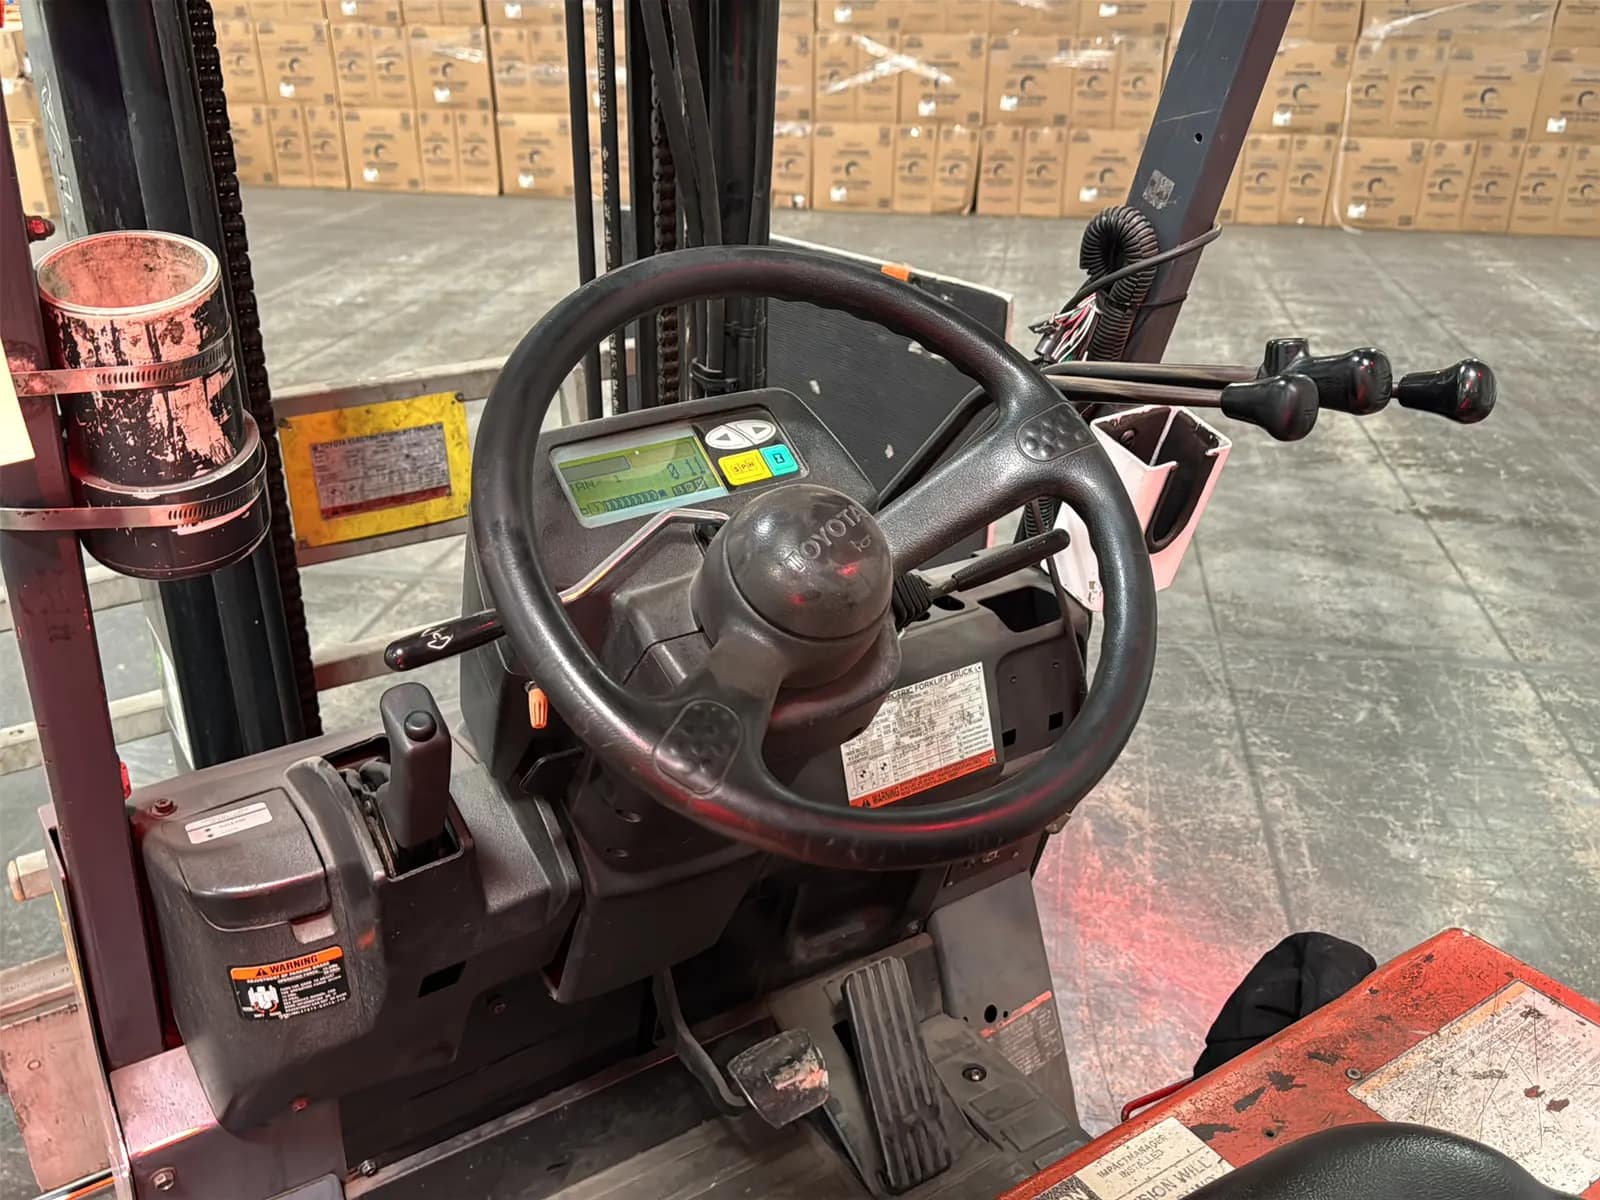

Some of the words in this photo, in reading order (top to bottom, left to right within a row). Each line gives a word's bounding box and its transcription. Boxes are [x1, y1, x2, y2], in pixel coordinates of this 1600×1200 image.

[783, 504, 865, 572] TOYOTA
[915, 676, 950, 693] FORKLIFT
[950, 668, 973, 682] TRUCK
[269, 956, 317, 972] WARNING
[1097, 1134, 1169, 1178] IMPACTMANAGER
[1120, 1149, 1164, 1179] INSTALLED
[1173, 1158, 1212, 1183] WILL
